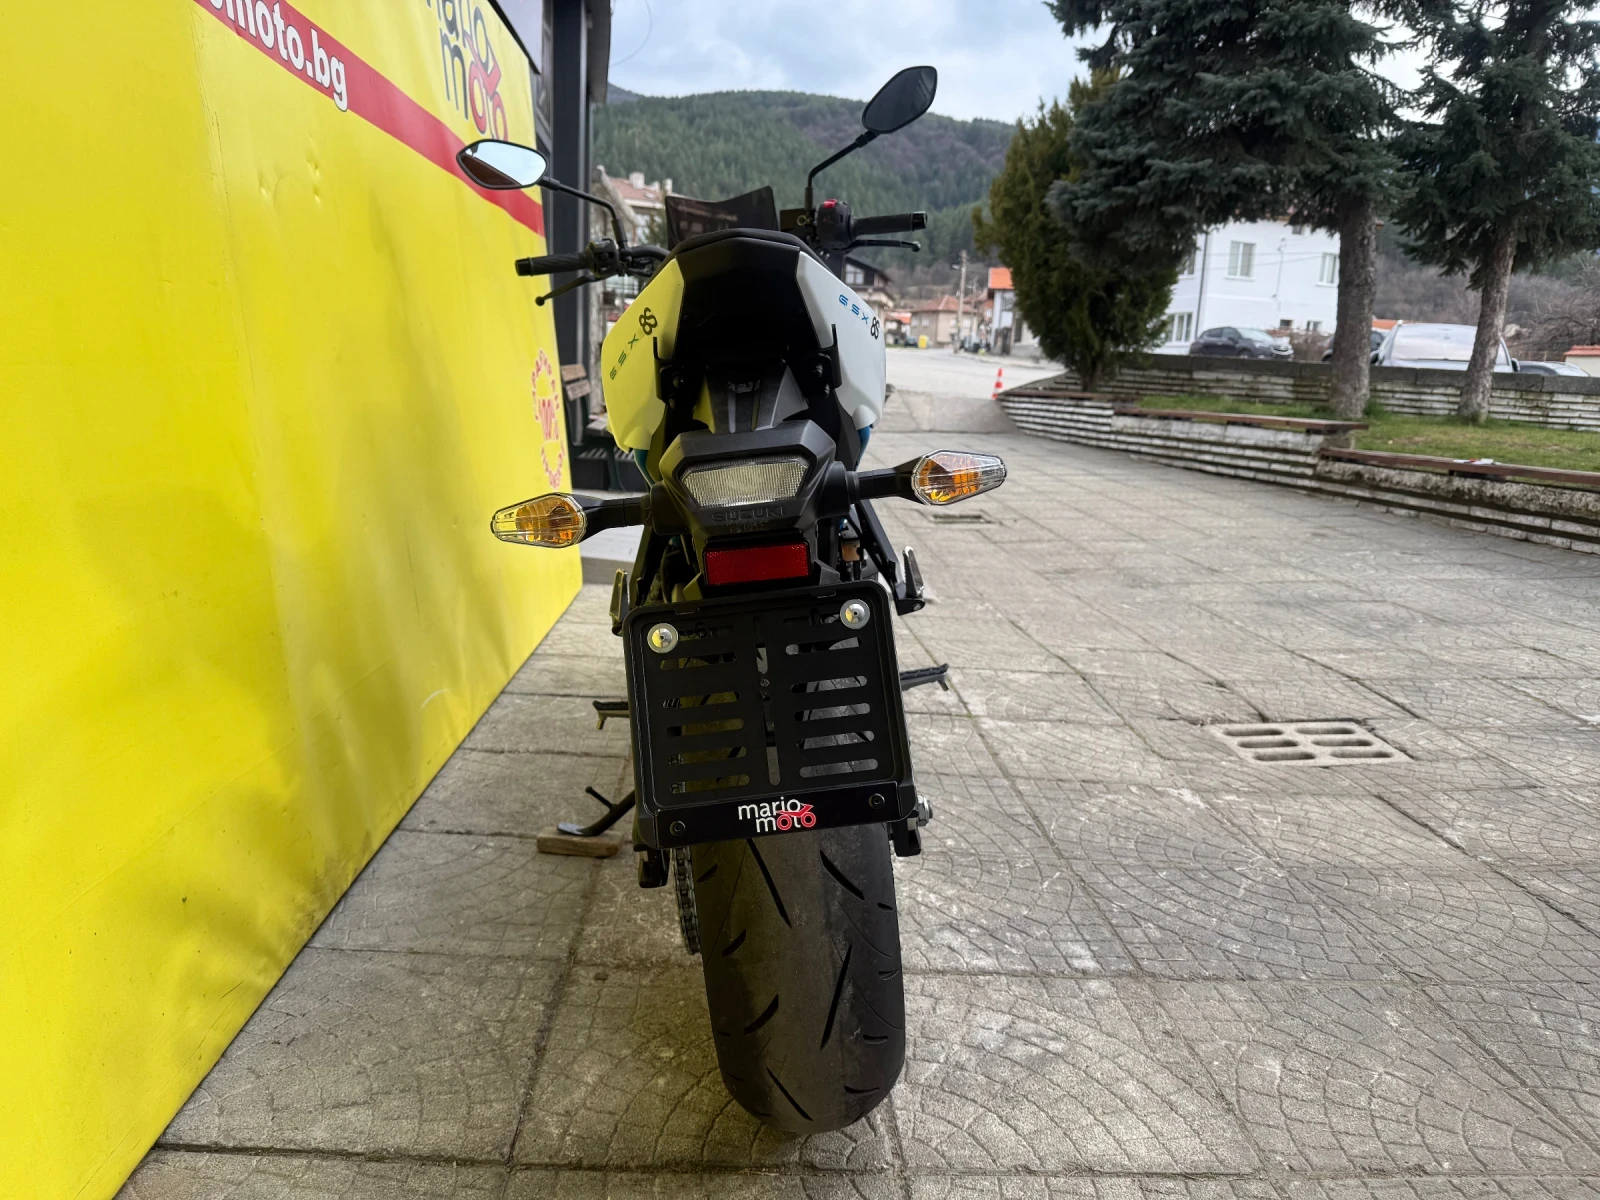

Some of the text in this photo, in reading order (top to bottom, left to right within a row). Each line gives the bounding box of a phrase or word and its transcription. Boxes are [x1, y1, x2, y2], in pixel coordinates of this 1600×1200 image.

[209, 0, 348, 112] moto.bg
[838, 294, 869, 325] GSX
[711, 505, 785, 524] SUZUKI
[737, 796, 801, 819] mario
[755, 811, 817, 833] moto
